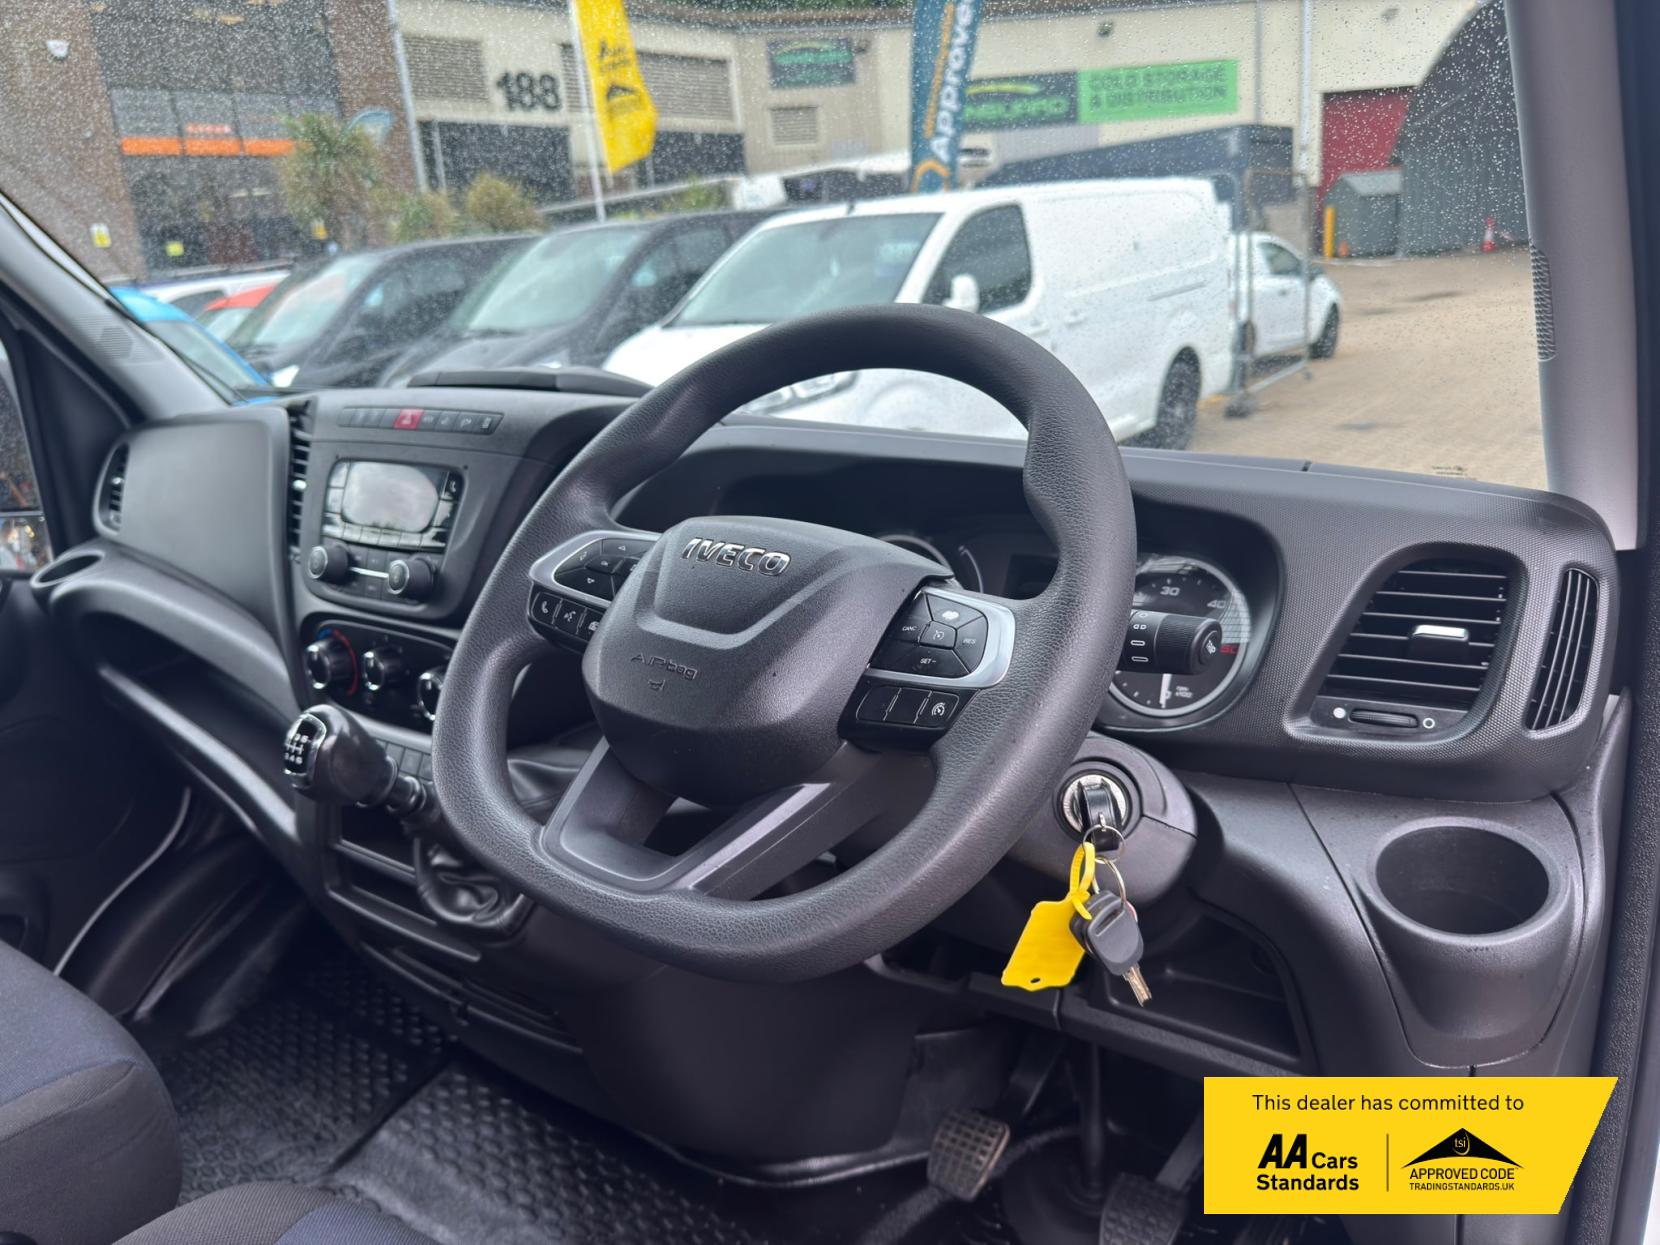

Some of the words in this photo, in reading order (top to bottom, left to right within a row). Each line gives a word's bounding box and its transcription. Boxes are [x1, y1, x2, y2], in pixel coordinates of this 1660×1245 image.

[496, 71, 561, 112] 188
[682, 536, 792, 577] IVECO
[1160, 586, 1180, 596] 30
